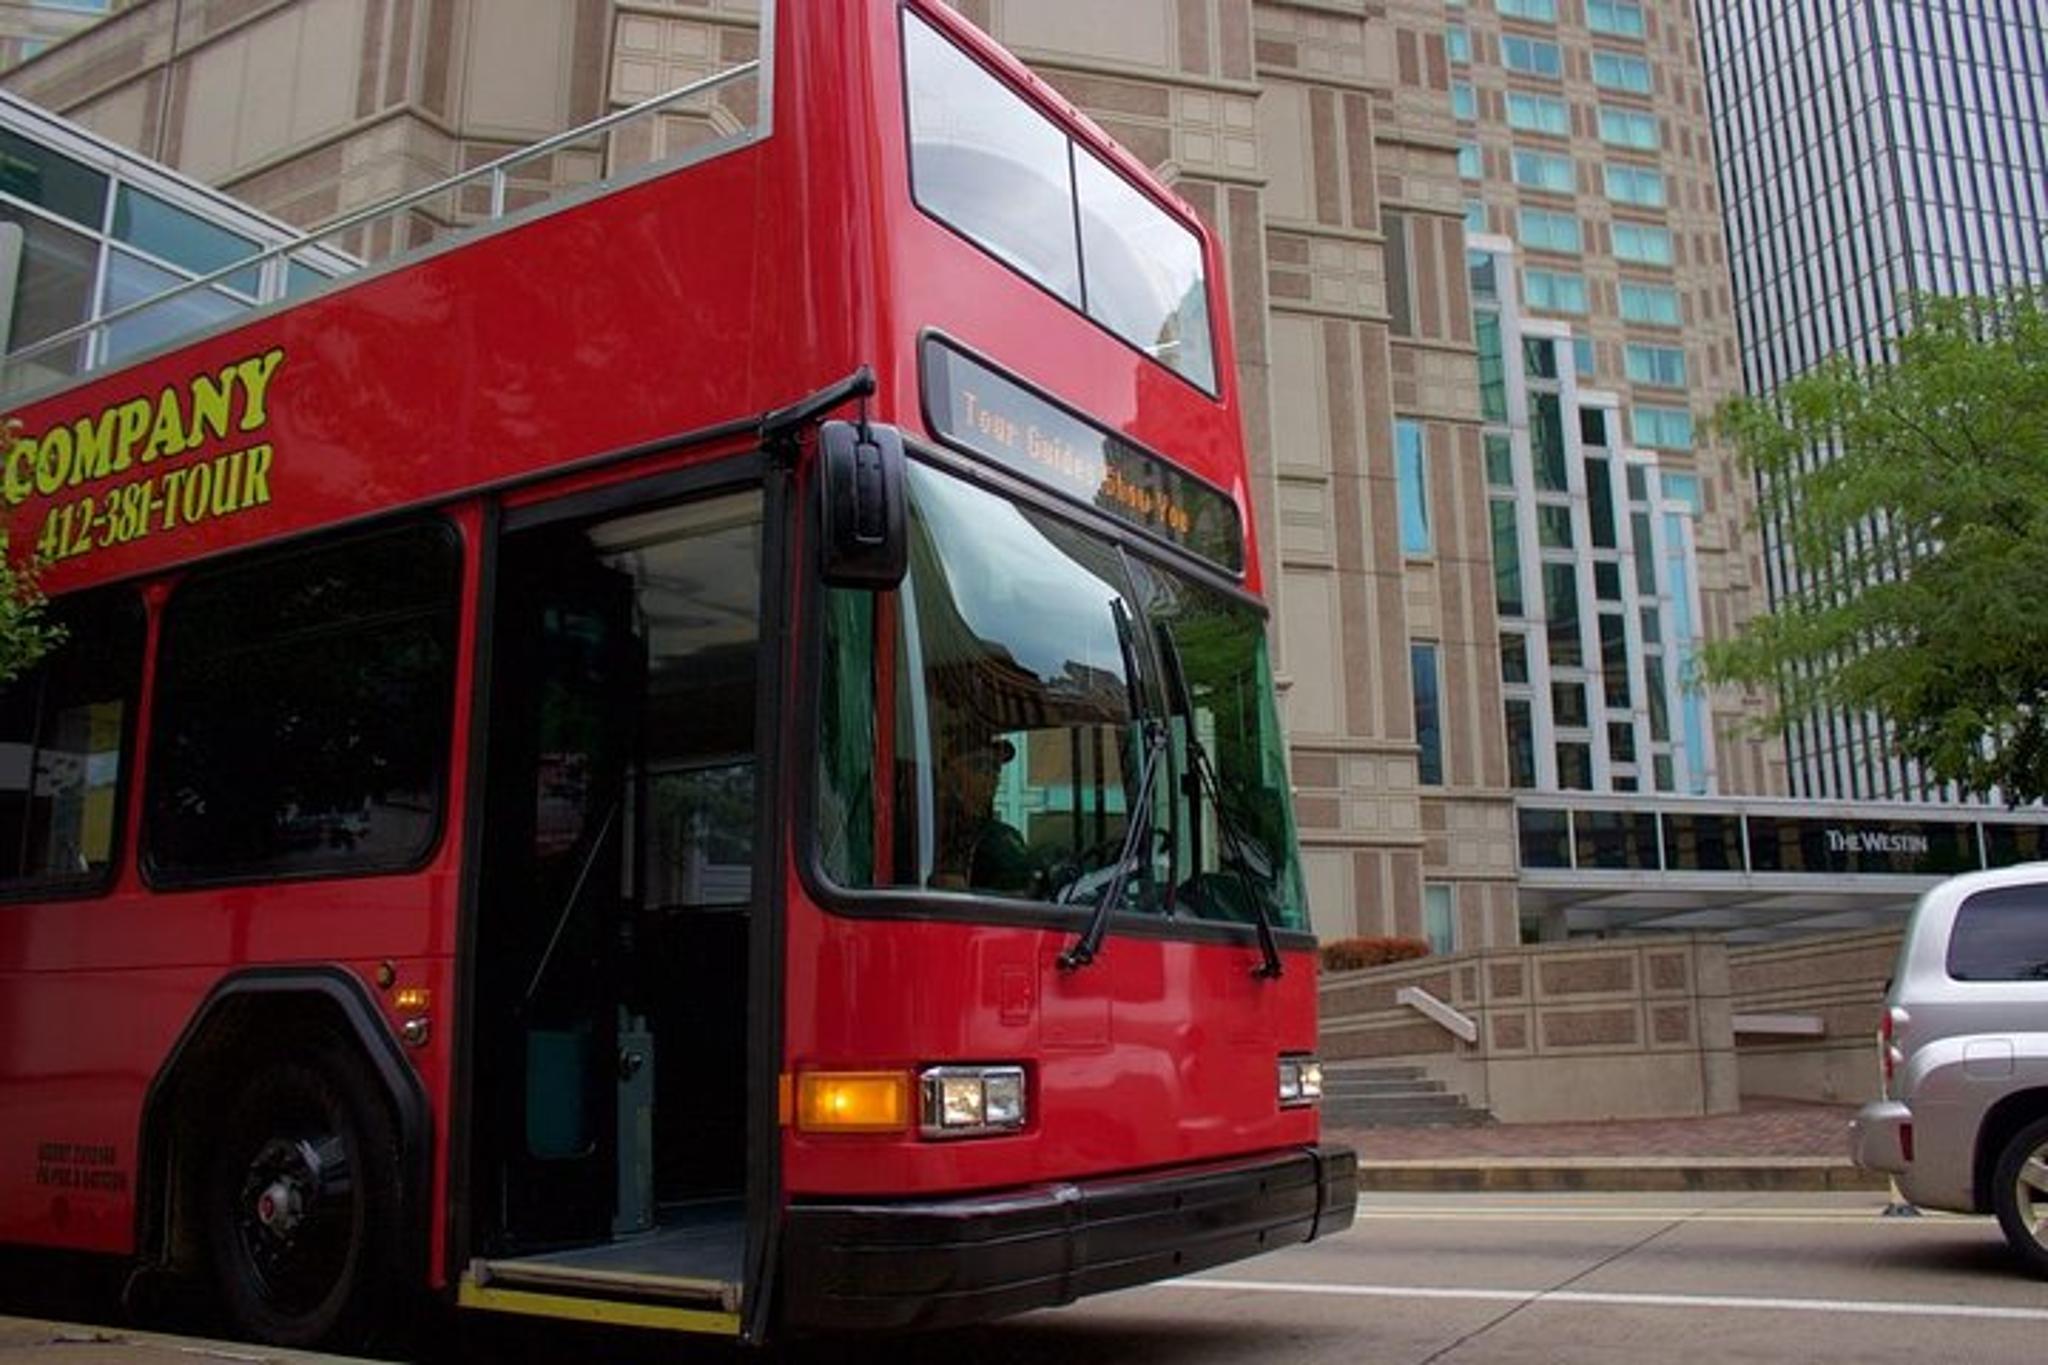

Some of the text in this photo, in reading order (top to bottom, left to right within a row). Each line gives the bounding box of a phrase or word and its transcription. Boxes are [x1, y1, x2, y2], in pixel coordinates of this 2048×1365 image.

[4, 348, 284, 504] COMPANY
[961, 390, 1014, 446] Tour
[37, 444, 272, 564] 412-381-TOUR
[1860, 830, 1928, 853] WESTIN
